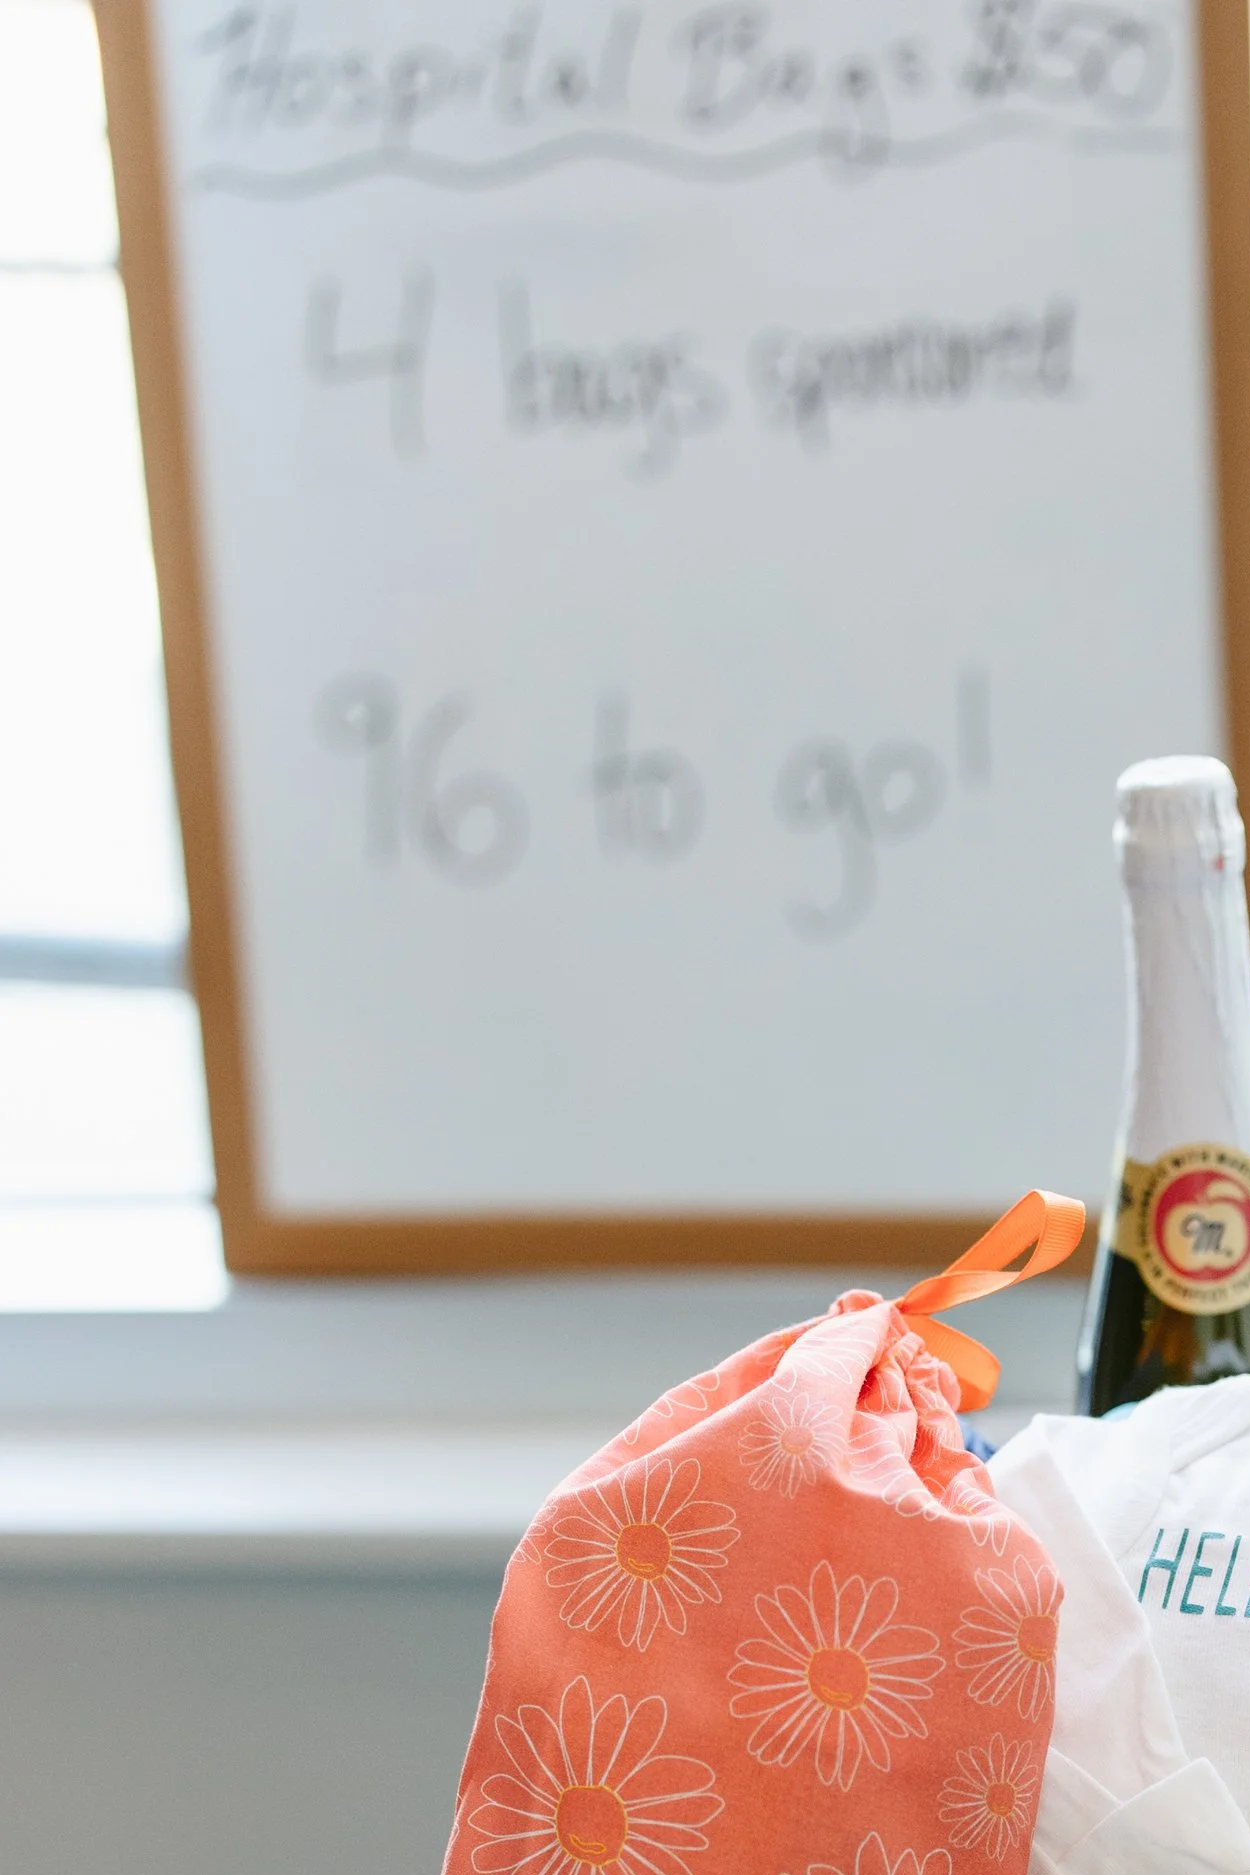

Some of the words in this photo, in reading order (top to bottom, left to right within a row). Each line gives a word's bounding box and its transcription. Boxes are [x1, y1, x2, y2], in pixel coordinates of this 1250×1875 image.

[306, 266, 436, 460] 4
[312, 670, 530, 888] 96
[592, 680, 706, 865] to
[775, 658, 991, 944] go!
